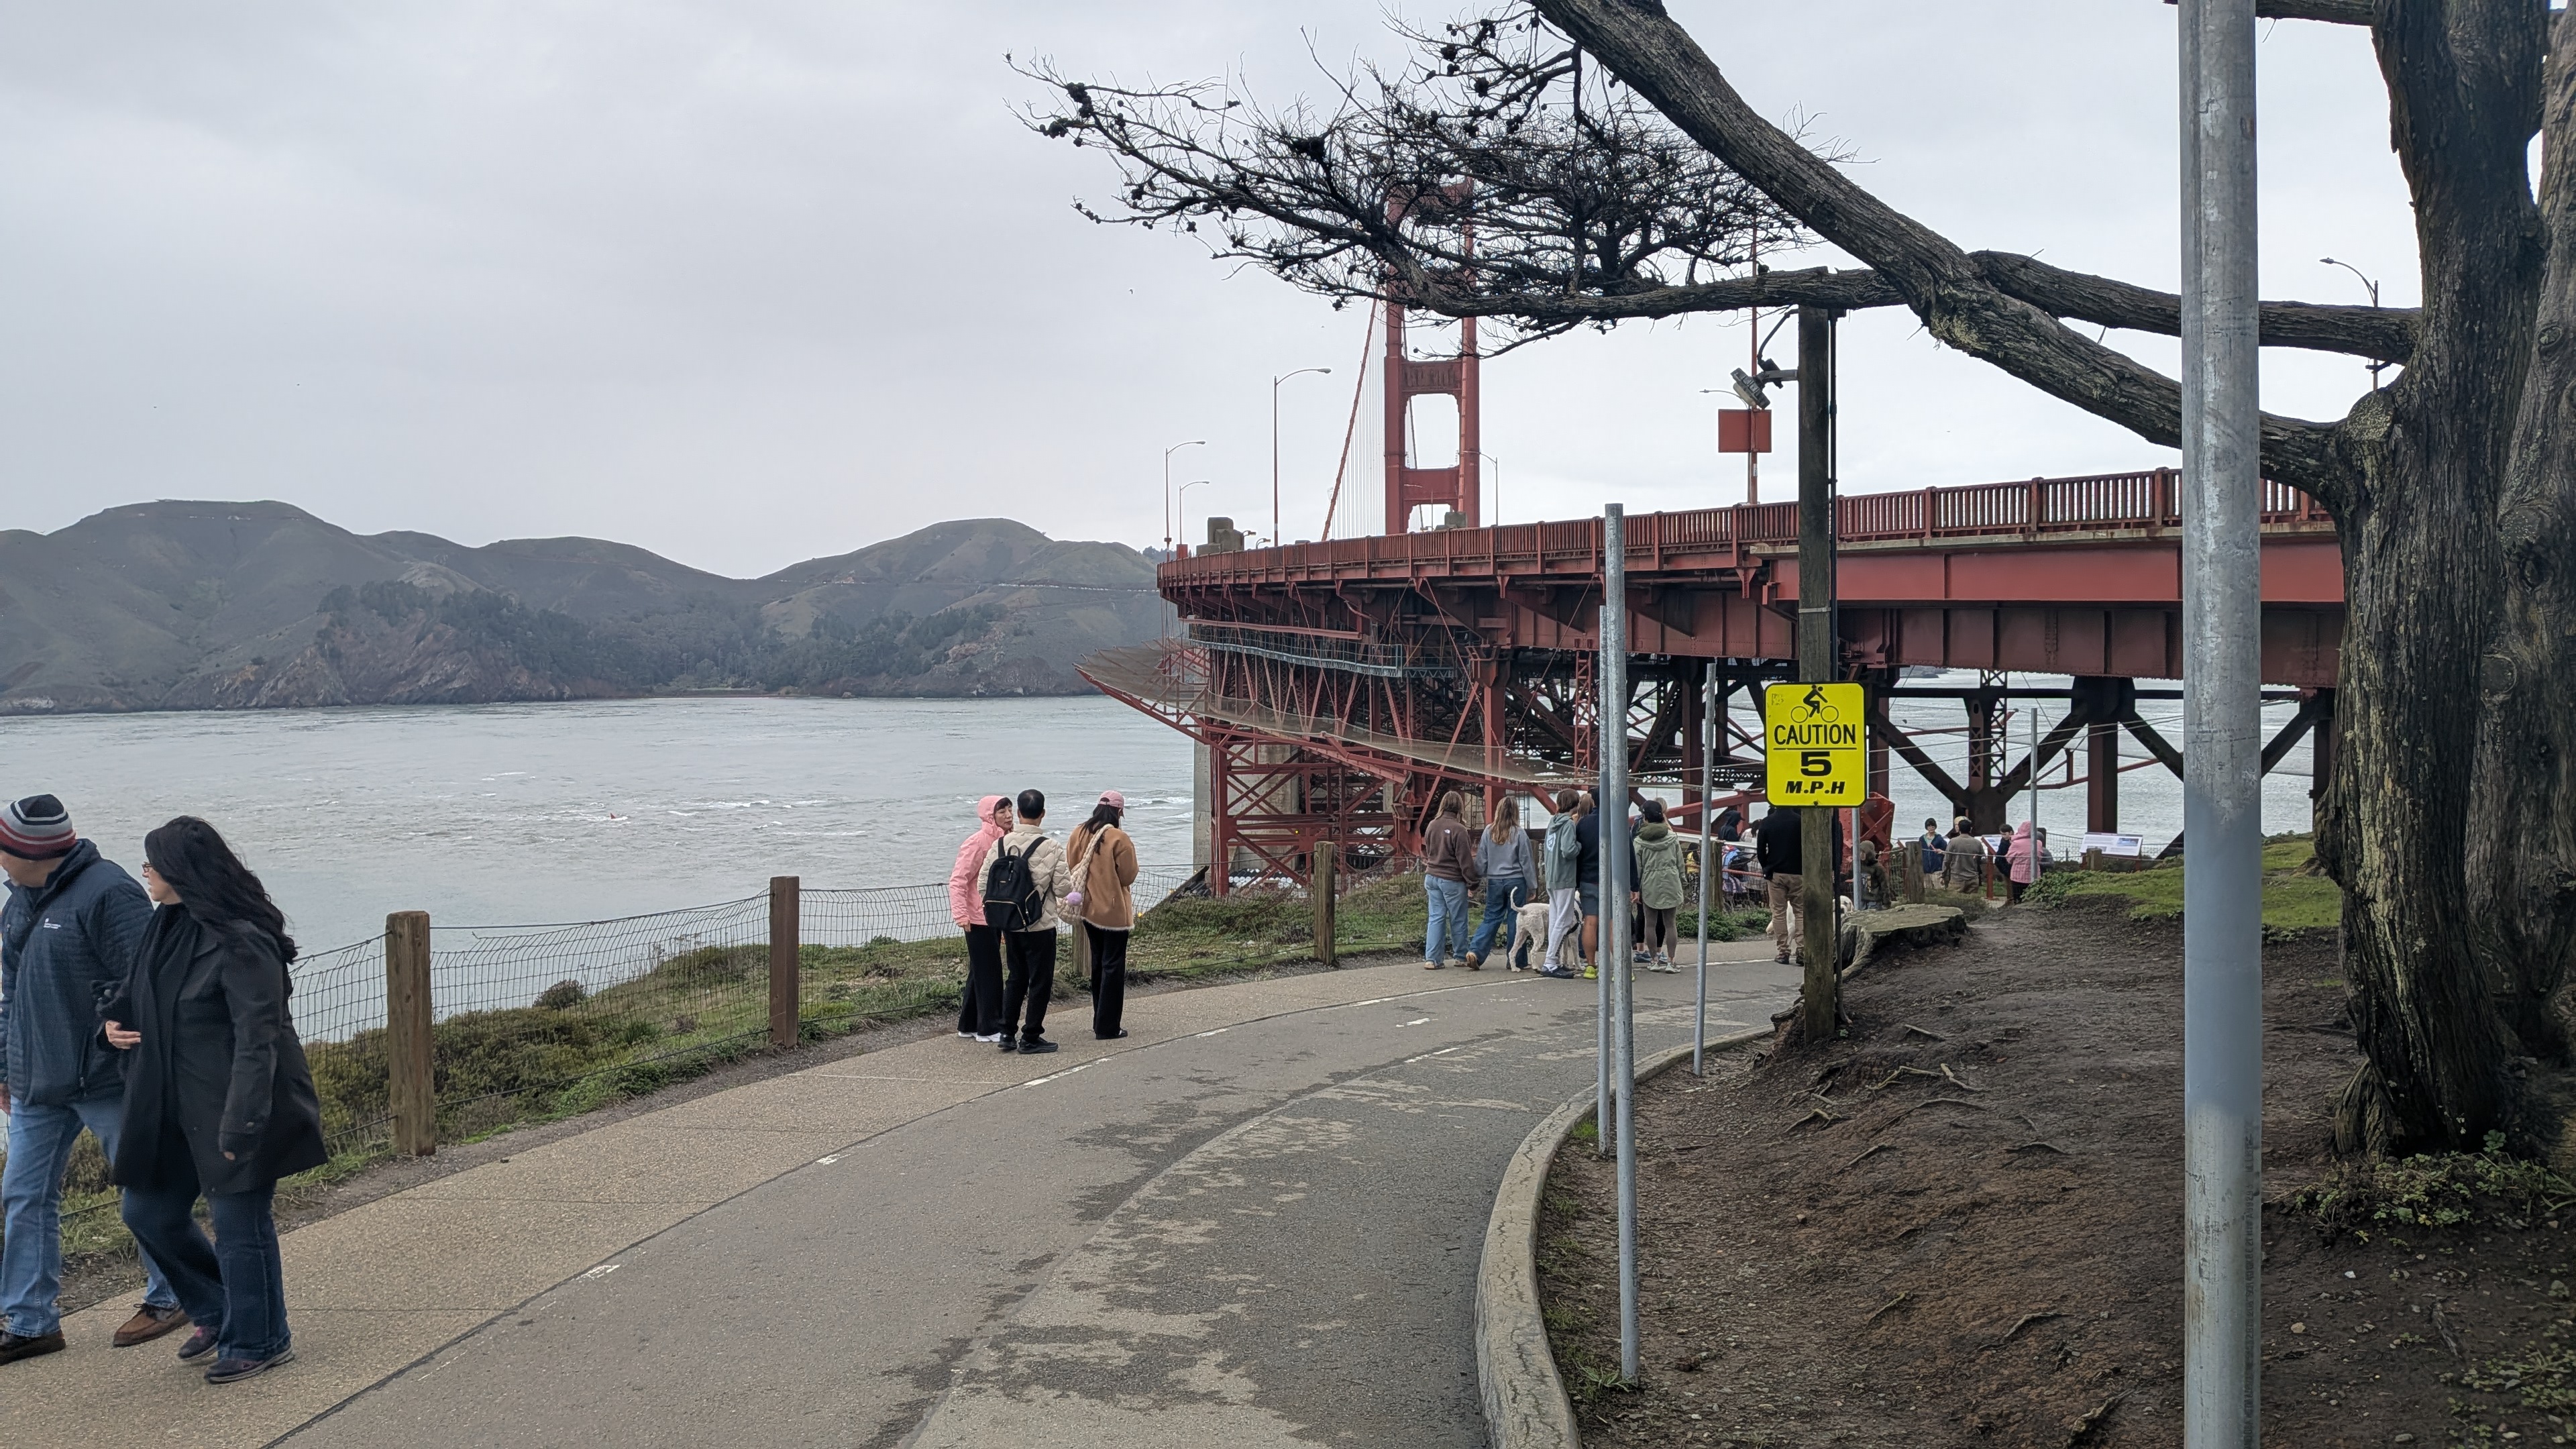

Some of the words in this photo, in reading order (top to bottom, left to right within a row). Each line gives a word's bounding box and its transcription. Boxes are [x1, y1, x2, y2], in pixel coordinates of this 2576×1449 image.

[1774, 724, 1856, 745] CAUTION
[1800, 751, 1832, 777] 5
[1785, 781, 1845, 794] M.P.H
